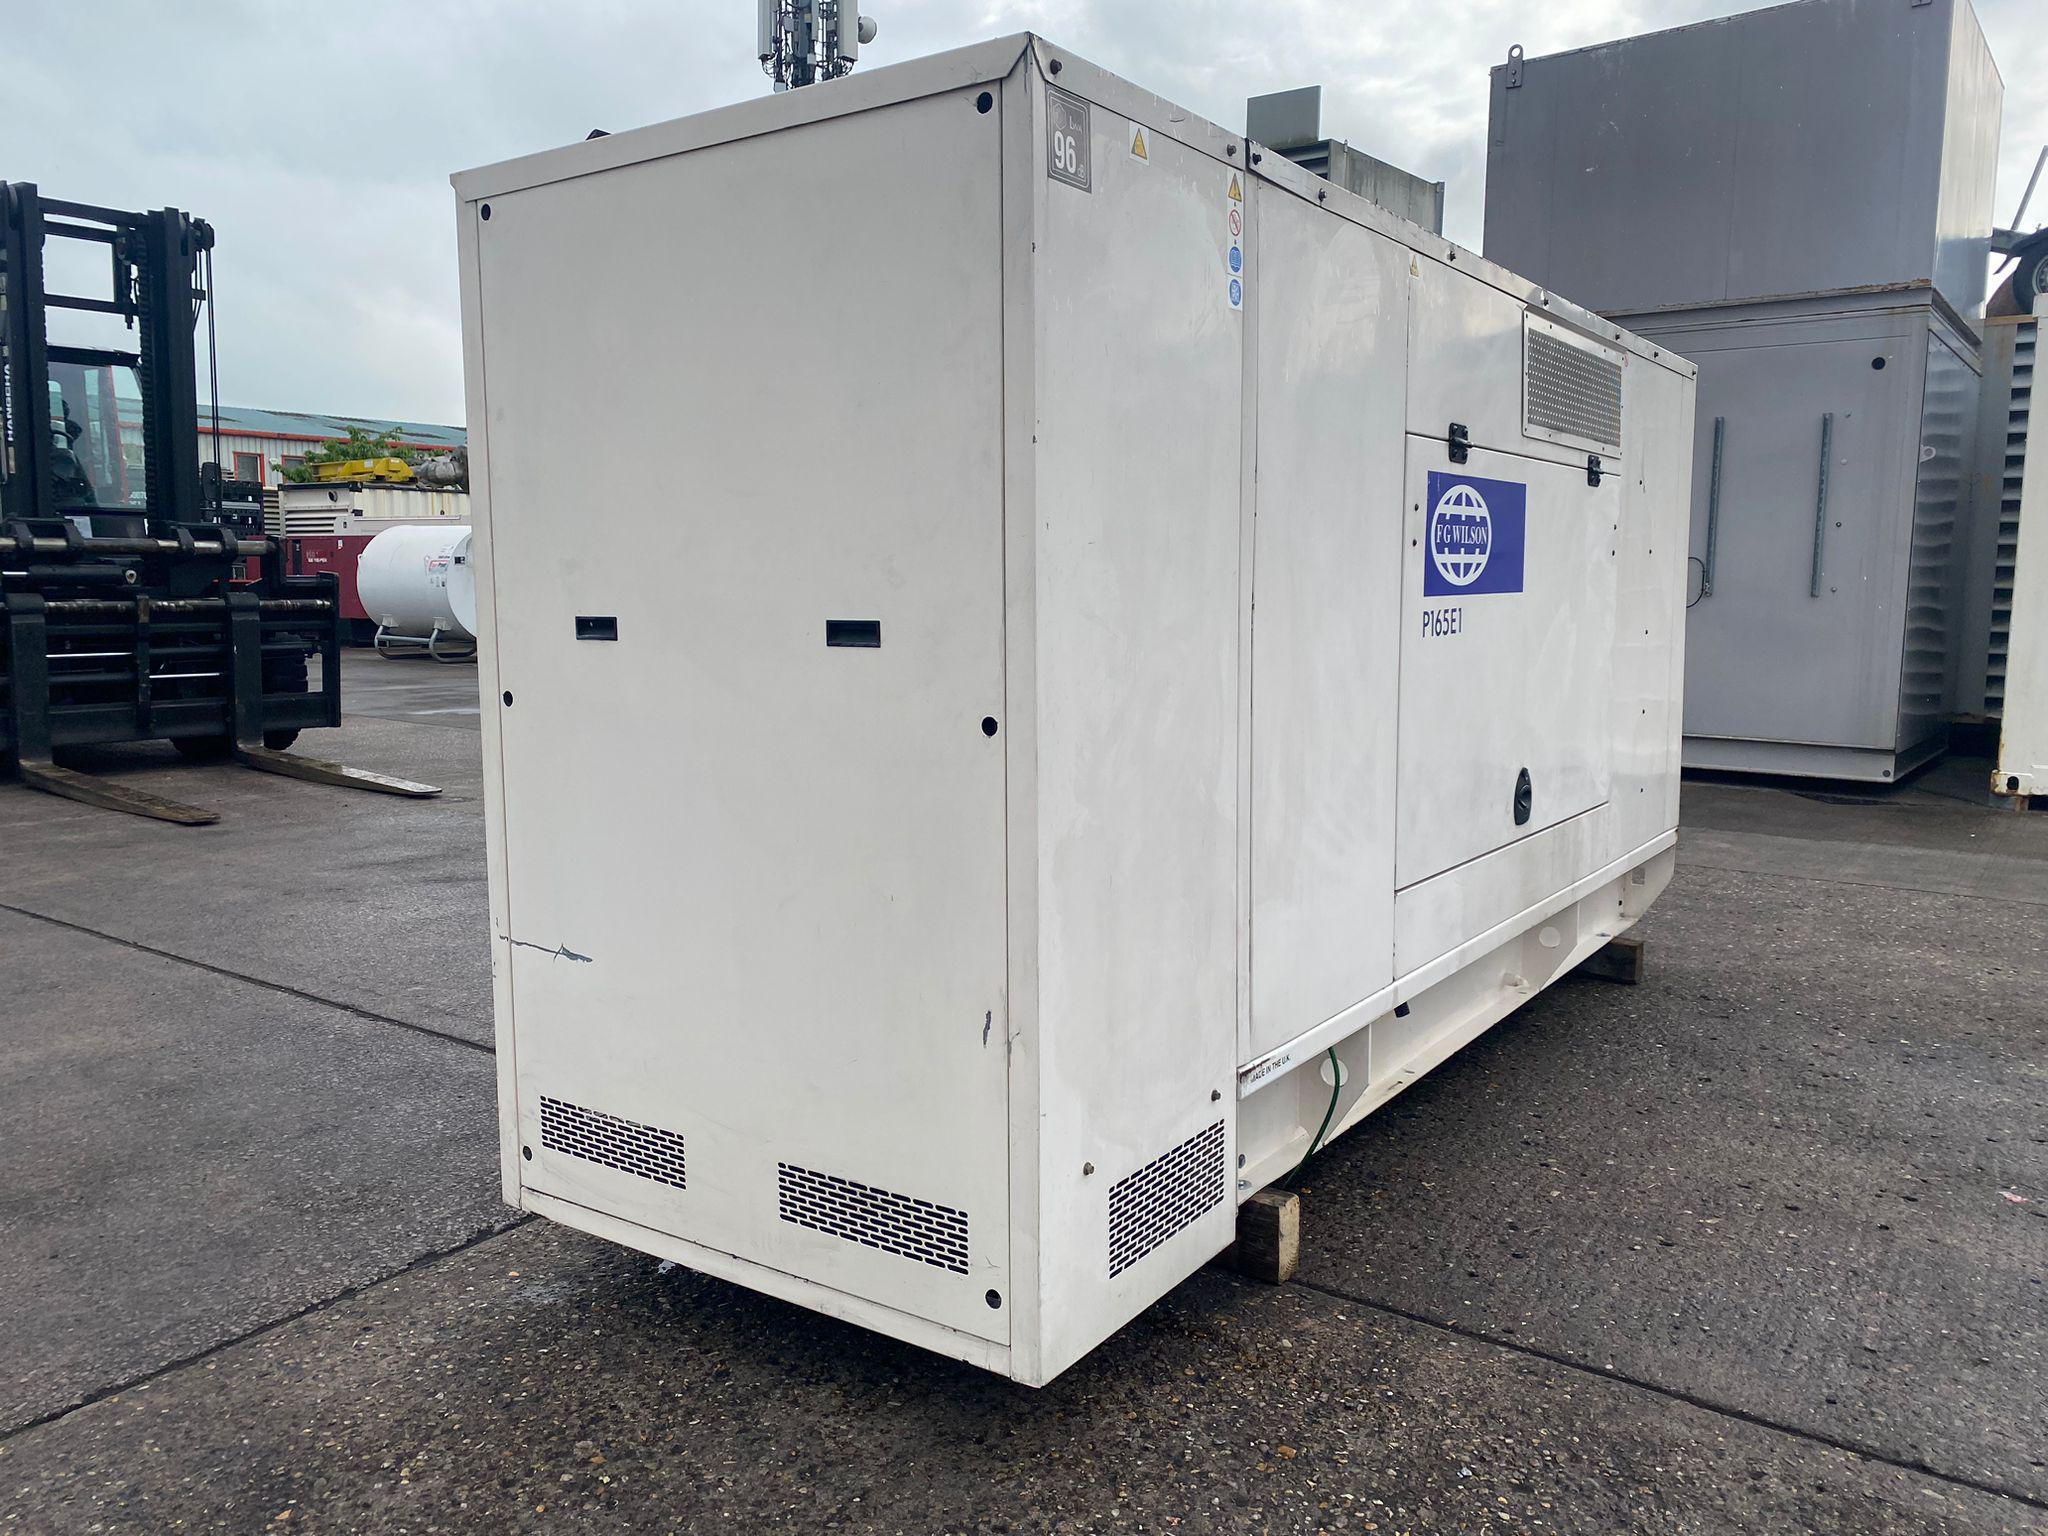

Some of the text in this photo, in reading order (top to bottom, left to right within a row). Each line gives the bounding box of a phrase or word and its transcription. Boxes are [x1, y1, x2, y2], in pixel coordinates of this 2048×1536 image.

[1054, 130, 1077, 174] 96
[1452, 525, 1488, 545] WILSON
[1422, 607, 1462, 638] P165E1
[1266, 1064, 1272, 1074] IN
[1272, 1058, 1282, 1070] THE
